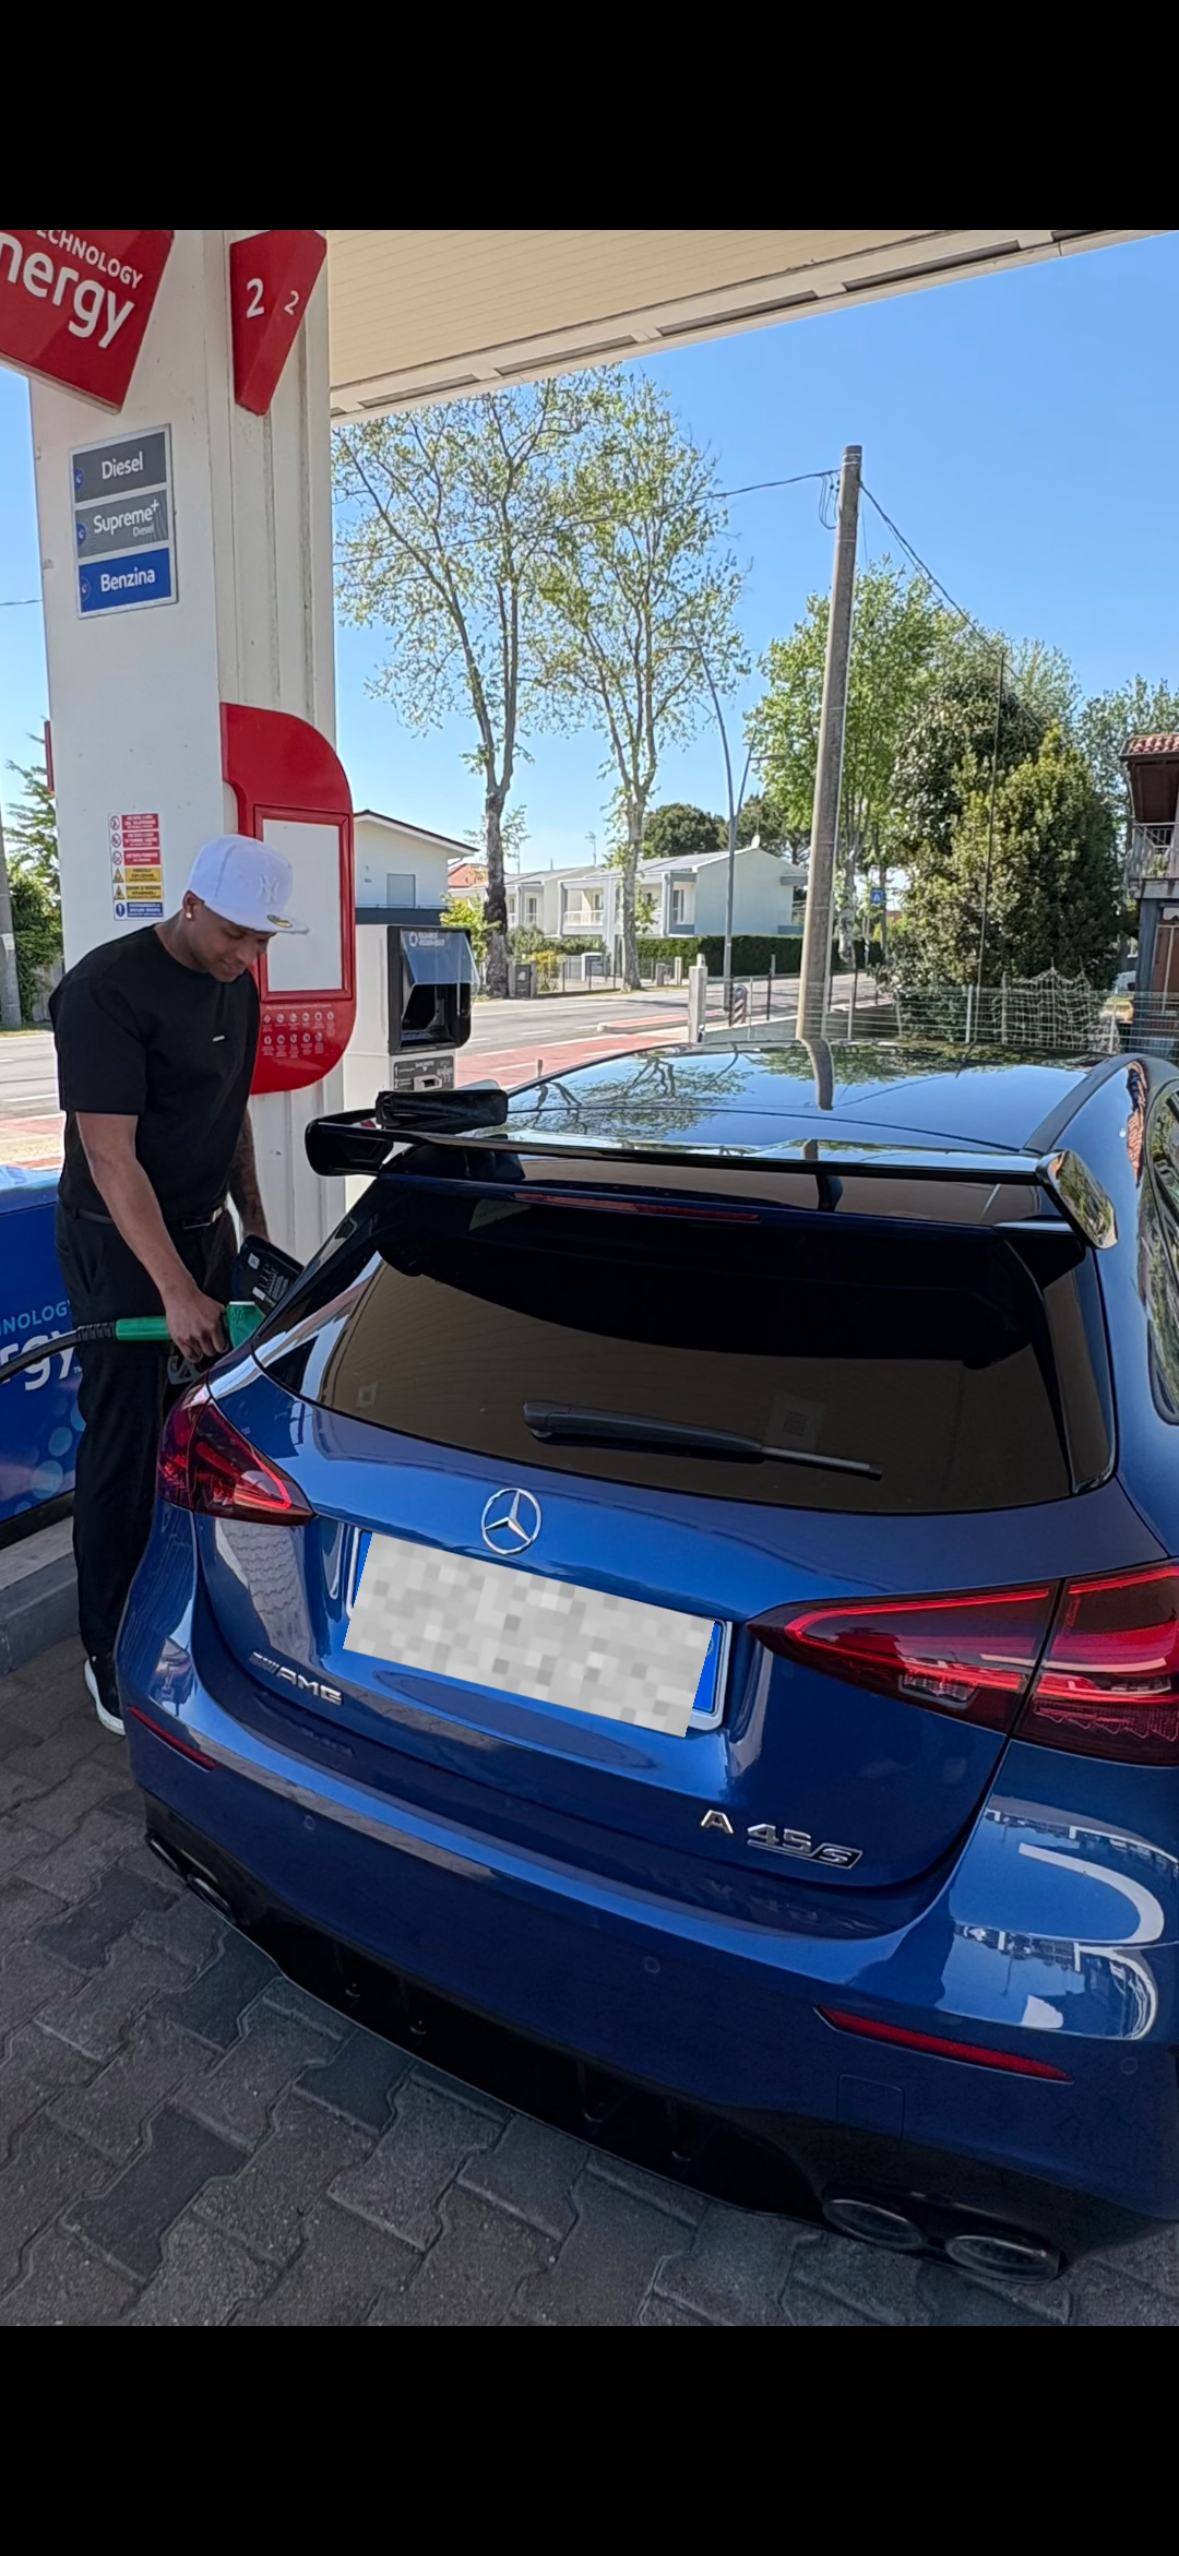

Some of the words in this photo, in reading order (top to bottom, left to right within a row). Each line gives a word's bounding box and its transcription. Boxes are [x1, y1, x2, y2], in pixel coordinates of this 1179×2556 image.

[29, 230, 144, 290] CHNOLOGY
[246, 278, 265, 319] 2
[283, 290, 300, 316] 2
[101, 451, 144, 481] Diesel
[132, 524, 155, 538] Diesel
[100, 566, 156, 593] Benzina
[0, 1299, 71, 1337] NOLOG
[275, 1664, 343, 1707] AMG
[700, 1809, 734, 1835] A
